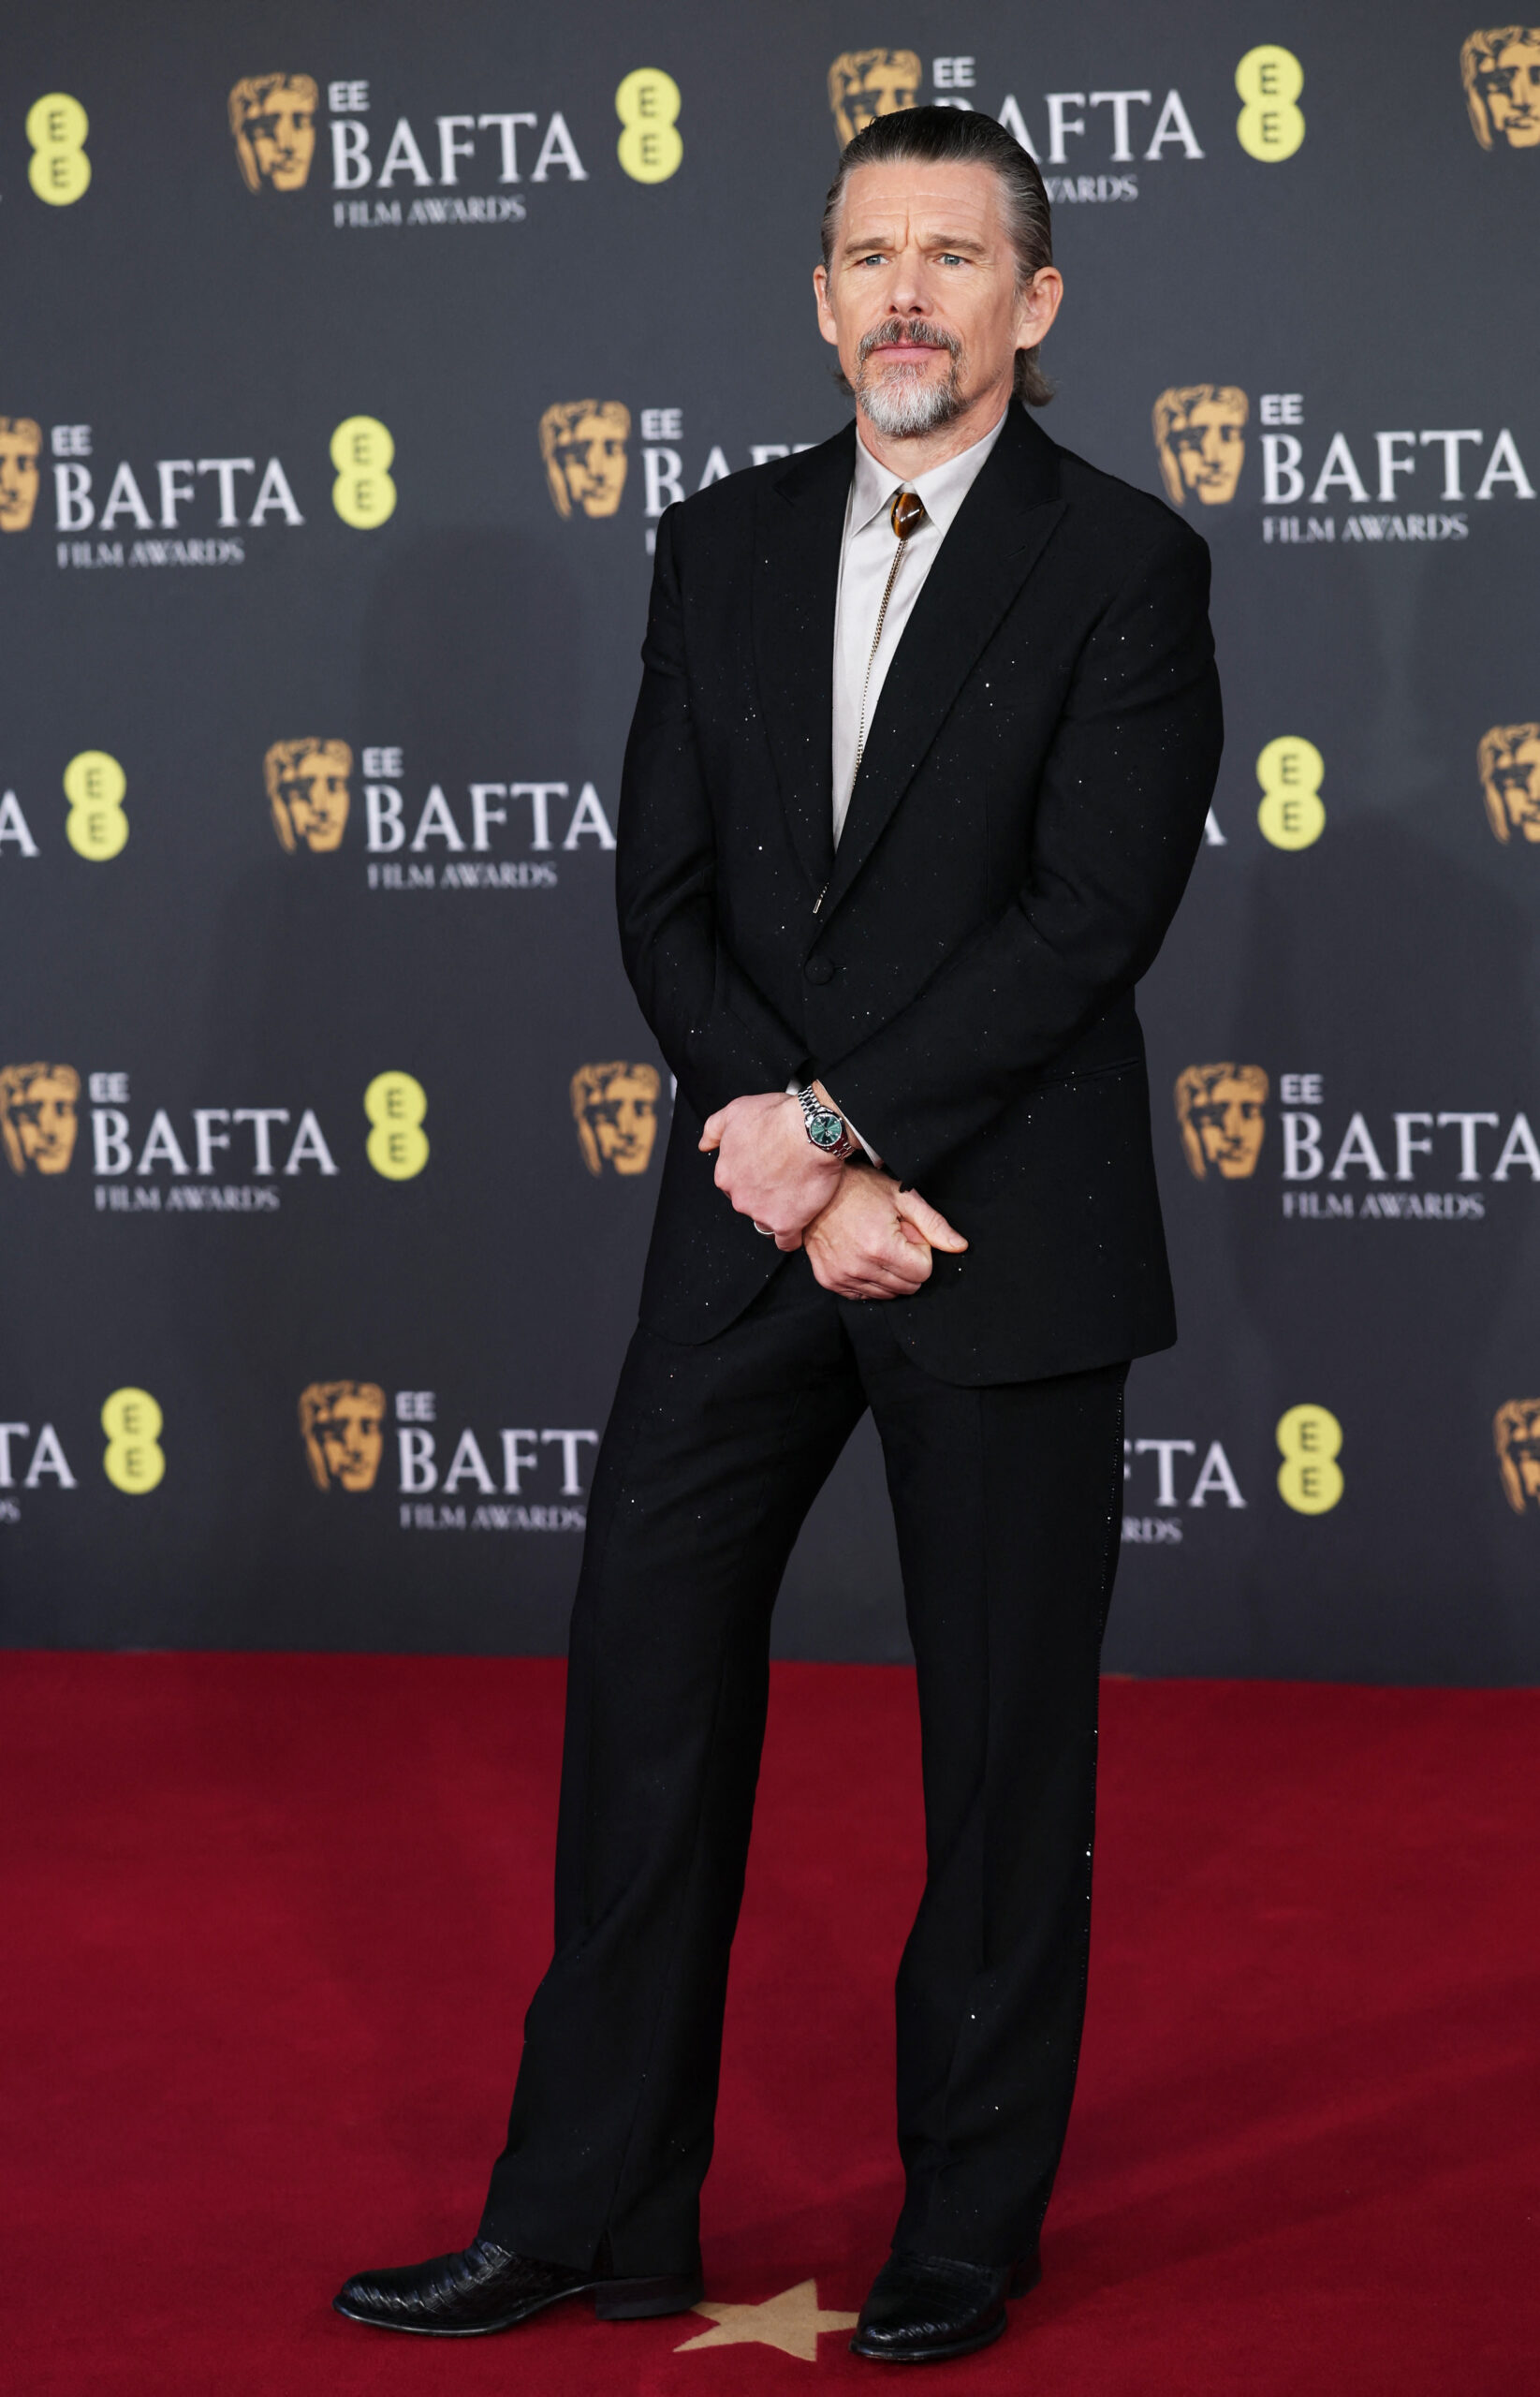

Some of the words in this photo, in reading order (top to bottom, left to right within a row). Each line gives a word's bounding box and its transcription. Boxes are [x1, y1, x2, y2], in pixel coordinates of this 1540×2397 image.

[933, 57, 975, 89] EE
[329, 81, 369, 112] EE
[932, 91, 1205, 164] AFTA
[330, 111, 588, 190] BAFTA
[333, 200, 403, 228] FILM
[410, 196, 526, 224] AWARDS
[641, 409, 682, 441] EE
[1260, 393, 1303, 426] EE
[51, 426, 91, 457] EE
[1261, 429, 1536, 505] BAFTA
[54, 458, 304, 532] BAFTA
[1263, 517, 1336, 543] FILM
[1342, 514, 1469, 540] AWARDS
[57, 542, 125, 567] FILM
[132, 538, 244, 566] AWARDS
[363, 747, 403, 778] EE
[364, 782, 618, 853] BAFTA
[368, 863, 436, 889] FILM
[442, 861, 557, 888] AWARDS
[90, 1072, 128, 1103] EE
[1281, 1074, 1323, 1105] EE
[91, 1109, 338, 1176] BAFTA
[1282, 1111, 1540, 1183] BAFTA
[95, 1186, 161, 1211] FILM
[166, 1185, 278, 1211] AWARDS
[1283, 1192, 1355, 1218] FILM
[1362, 1192, 1486, 1218] AWARDS
[395, 1391, 434, 1421] EE
[400, 1504, 467, 1530] FILM
[473, 1504, 586, 1530] AWARDS
